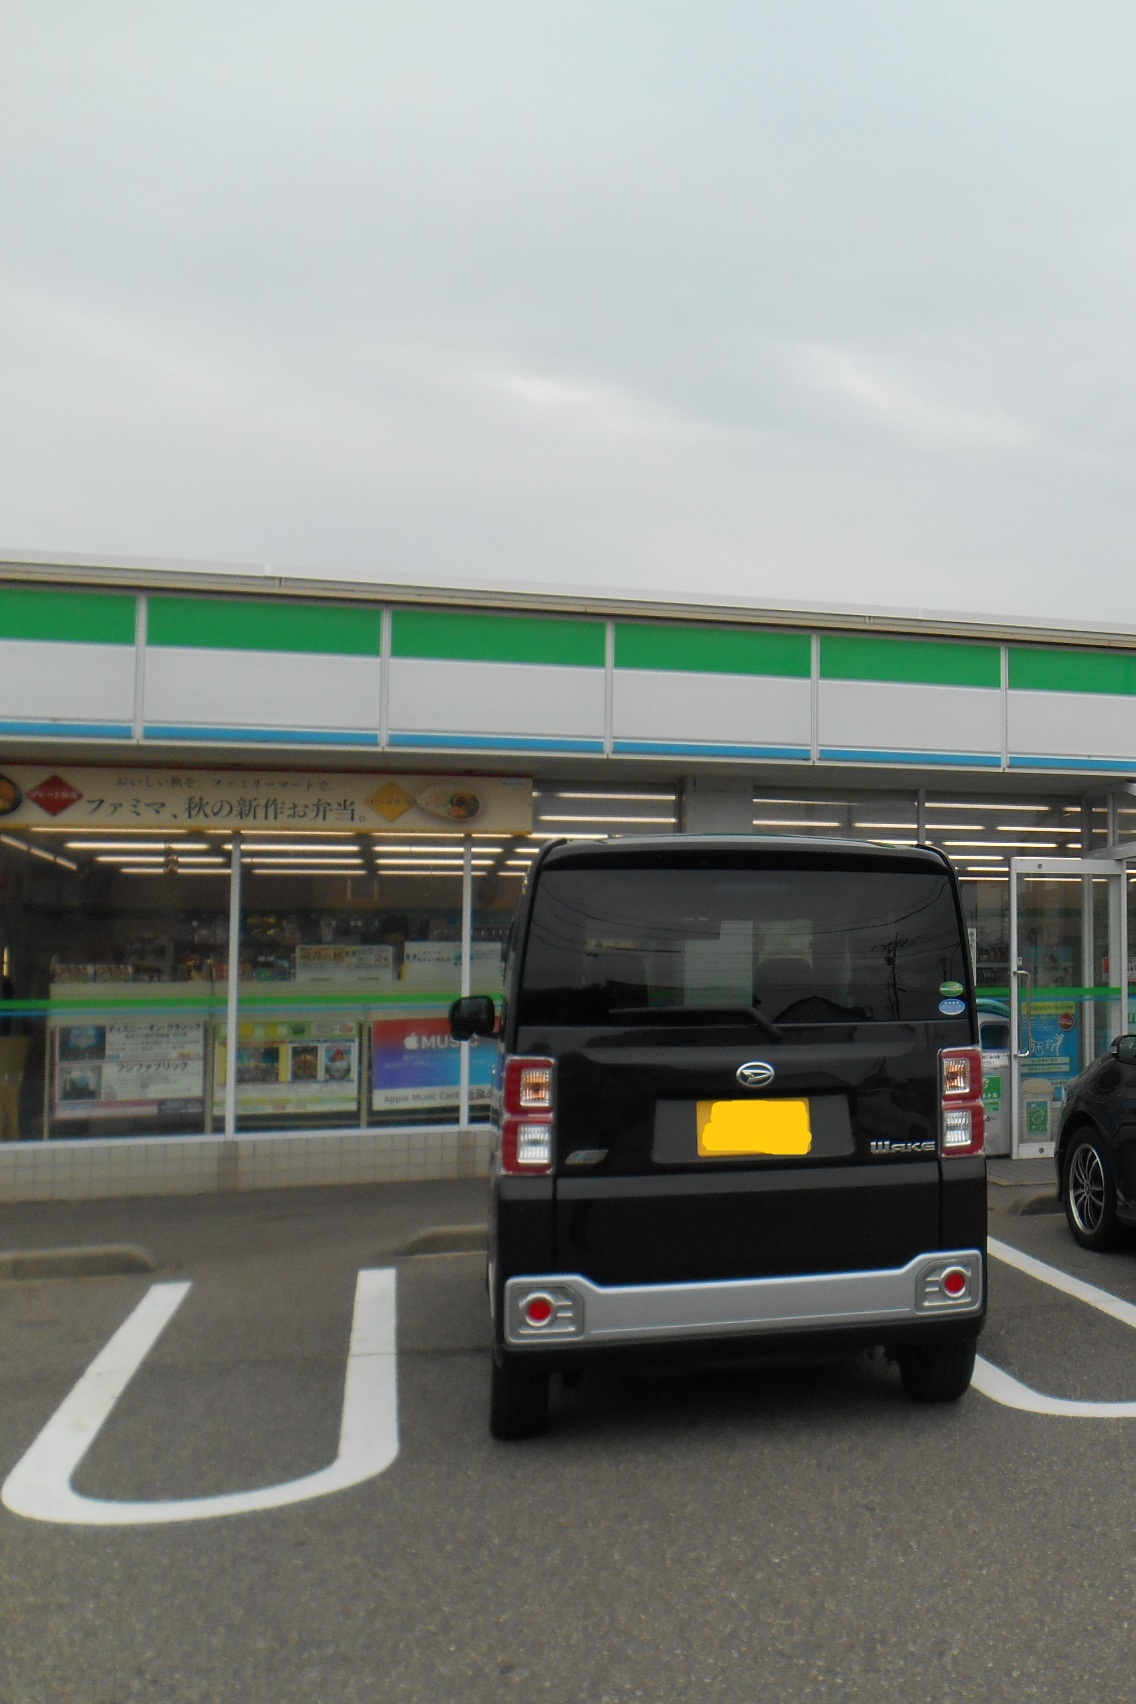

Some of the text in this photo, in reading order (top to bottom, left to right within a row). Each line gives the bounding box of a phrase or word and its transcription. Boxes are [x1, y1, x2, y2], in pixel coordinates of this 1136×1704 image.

[86, 796, 366, 822] ファミマ、秋の新作お弁当。
[421, 1033, 479, 1049] MUSC
[116, 1062, 188, 1073] フジファブリック
[383, 1094, 409, 1105] Apple
[412, 1091, 436, 1102] Music
[438, 1088, 460, 1100] Card
